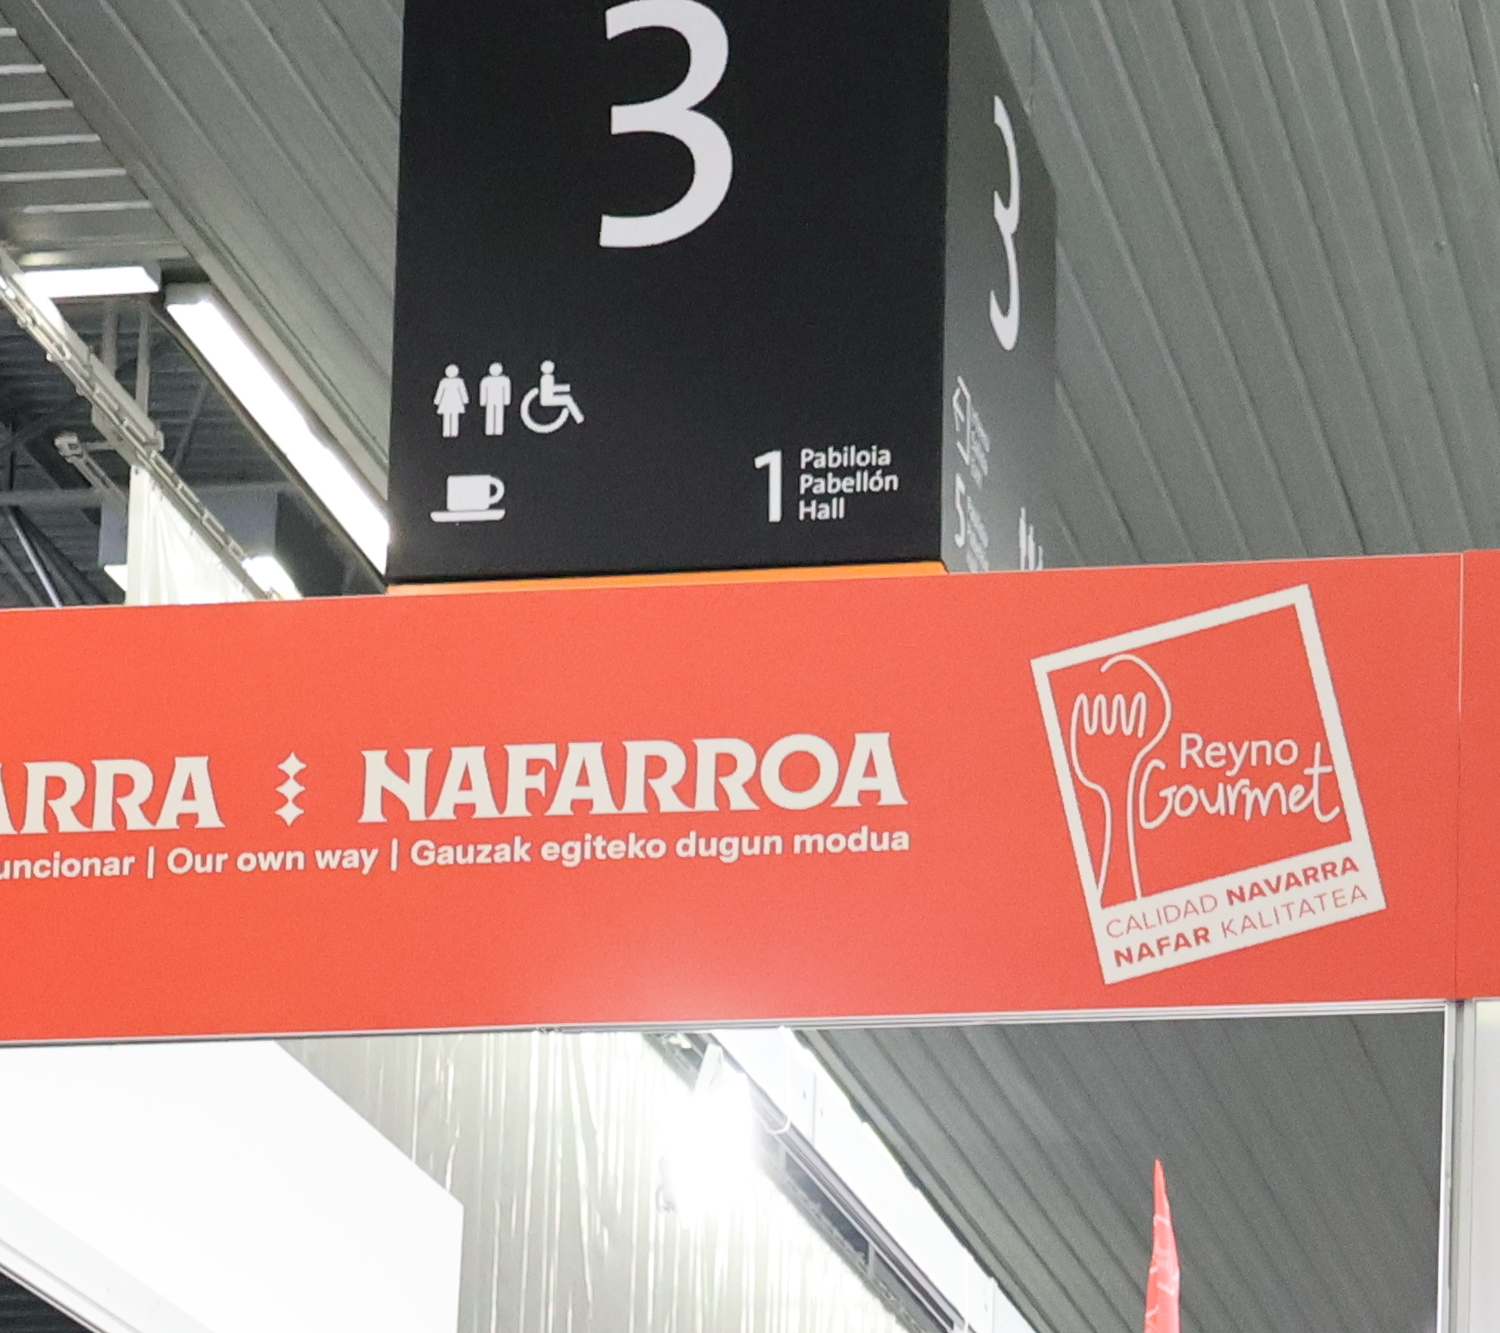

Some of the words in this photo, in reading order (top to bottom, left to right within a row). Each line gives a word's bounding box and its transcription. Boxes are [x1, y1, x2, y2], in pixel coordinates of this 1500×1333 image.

[600, 0, 733, 248] 3
[754, 450, 783, 522] 1
[799, 446, 891, 470] Pabiloia
[799, 470, 899, 496] Pabellón
[798, 497, 845, 522] Hall
[358, 732, 908, 823] NAFARROA
[1140, 742, 1340, 829] Gourmet
[1180, 733, 1298, 776] Reyno
[167, 847, 228, 875] Our
[237, 849, 305, 872] own
[315, 846, 379, 875] way
[411, 837, 531, 867] Gauzak
[541, 833, 666, 867] egiteko
[676, 830, 784, 863] dugun
[794, 826, 910, 855] modua
[1106, 895, 1218, 939] CALIDAD
[1226, 856, 1359, 906] NAVARRA
[1114, 927, 1211, 967] NAFAR
[1221, 885, 1368, 939] KALITATEA
